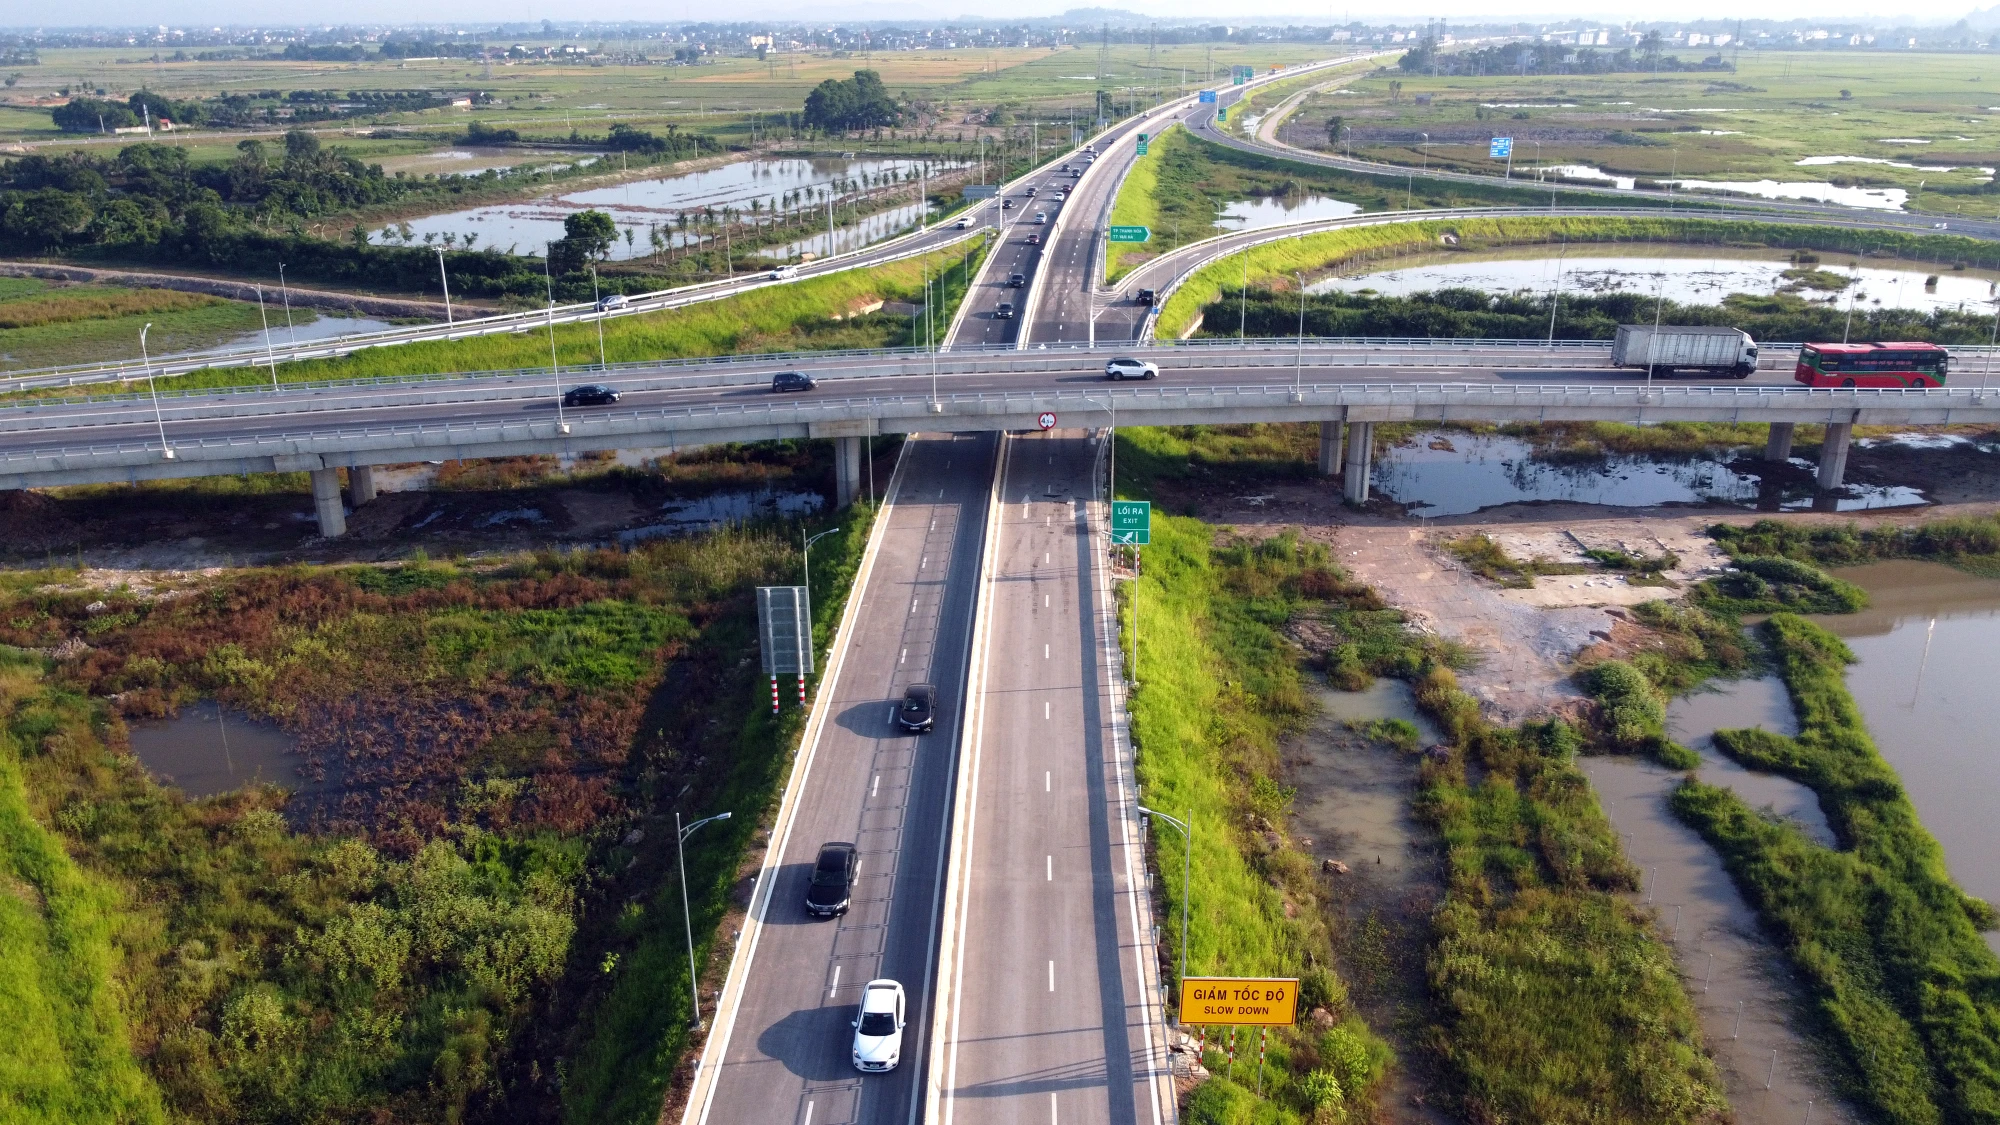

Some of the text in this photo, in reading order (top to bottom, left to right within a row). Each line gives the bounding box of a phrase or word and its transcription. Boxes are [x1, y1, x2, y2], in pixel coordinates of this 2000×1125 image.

[1118, 506, 1130, 515] LỐI
[1193, 984, 1285, 1003] GIẢM TỐC ĐỘ
[1204, 1006, 1269, 1015] SLOW DOWN
